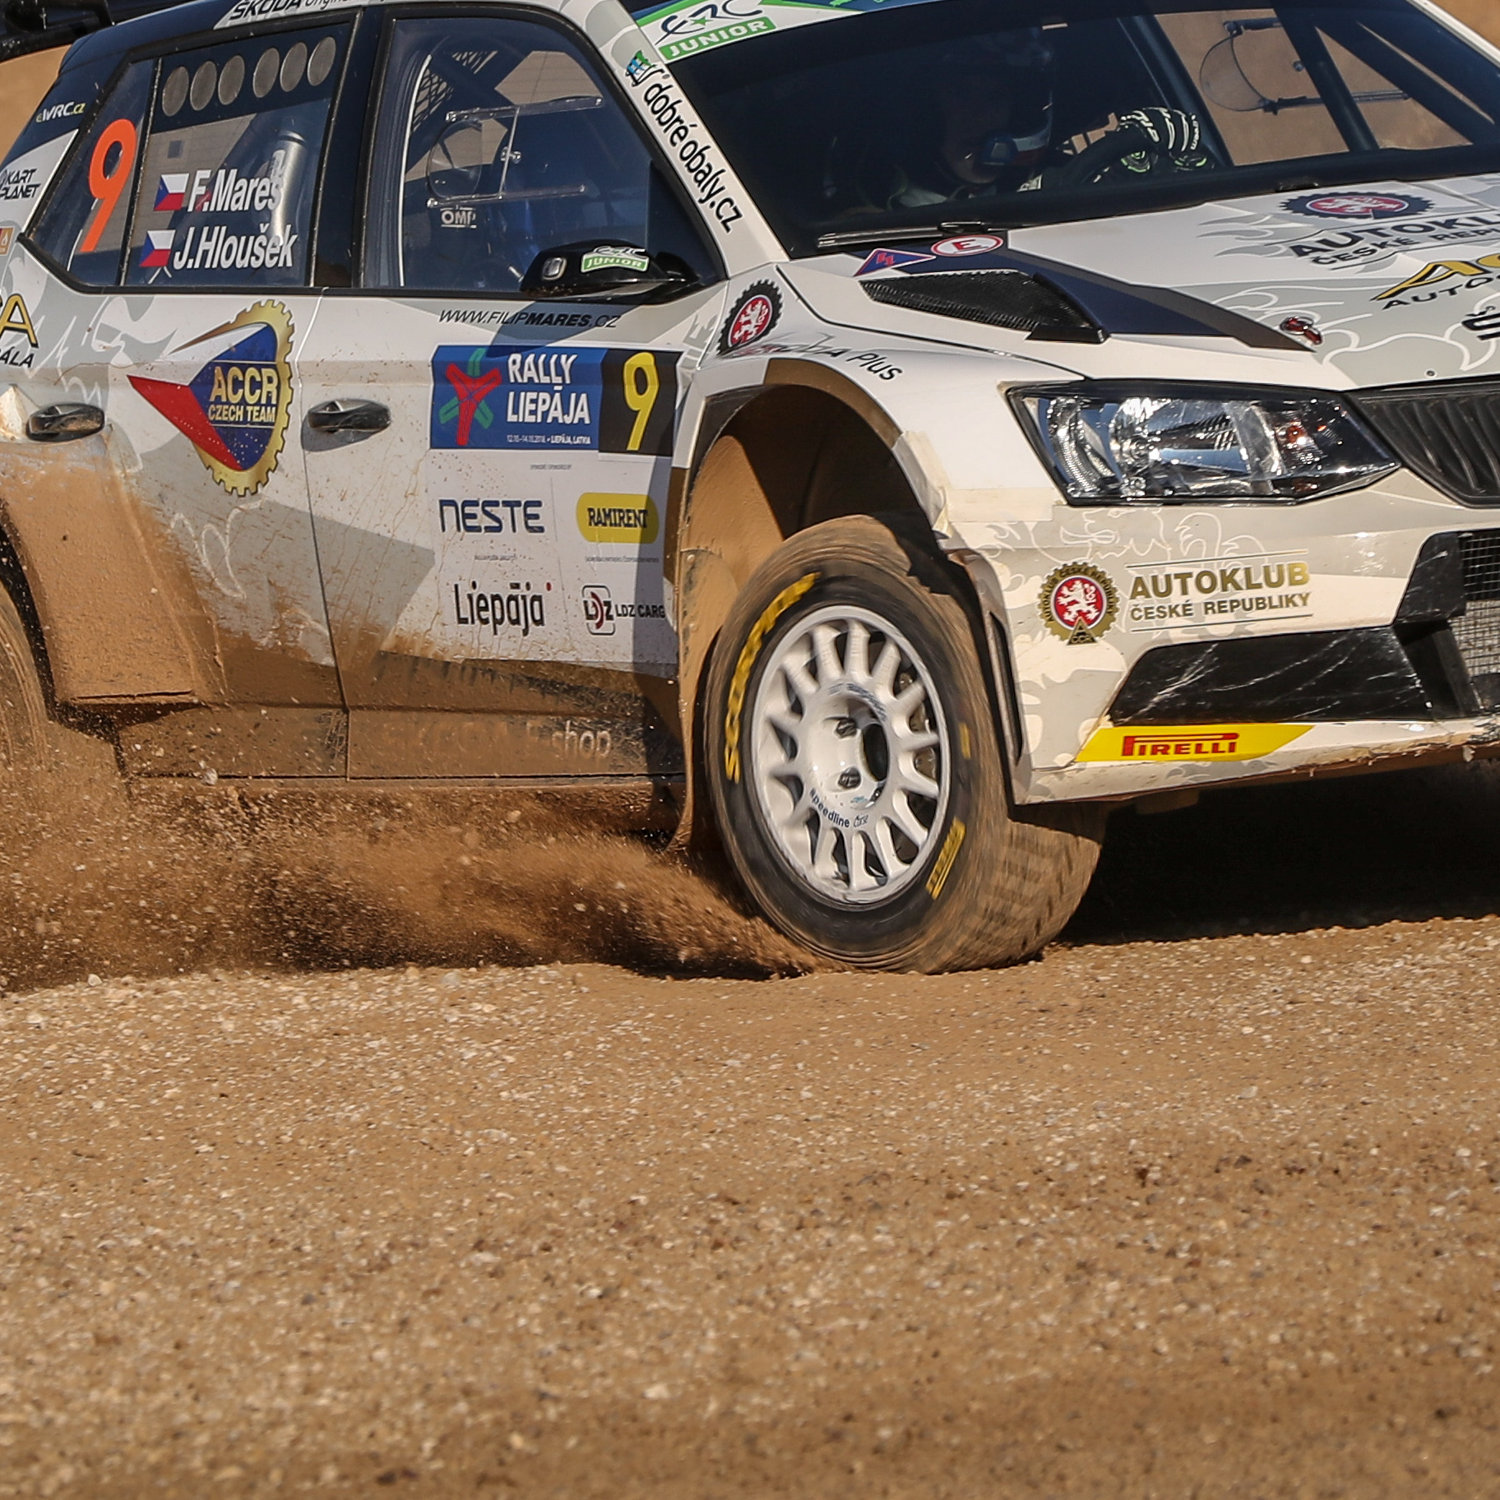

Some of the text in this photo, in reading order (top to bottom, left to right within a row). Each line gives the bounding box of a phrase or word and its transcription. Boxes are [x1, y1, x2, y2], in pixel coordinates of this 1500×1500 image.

[668, 19, 770, 58] JUNIOR
[7, 168, 37, 185] KART
[80, 118, 137, 252] 9
[173, 223, 298, 269] J.Hloušek
[952, 239, 983, 251] E
[586, 257, 643, 269] JUNIOR
[507, 353, 578, 384] RALLY
[845, 351, 903, 381] Plus
[209, 366, 279, 404] ACCR
[207, 404, 276, 423] CZECH TEAM
[506, 385, 591, 425] LIEPĀJA
[623, 351, 660, 451] 9
[439, 499, 545, 533] NESTE
[587, 507, 649, 529] RAMIRENT
[1130, 562, 1310, 600] AUTOKLUB
[615, 604, 636, 618] LDZ
[1130, 592, 1311, 621] ČESKÉ REPUBLIKY
[1121, 732, 1240, 757] PIRELLI
